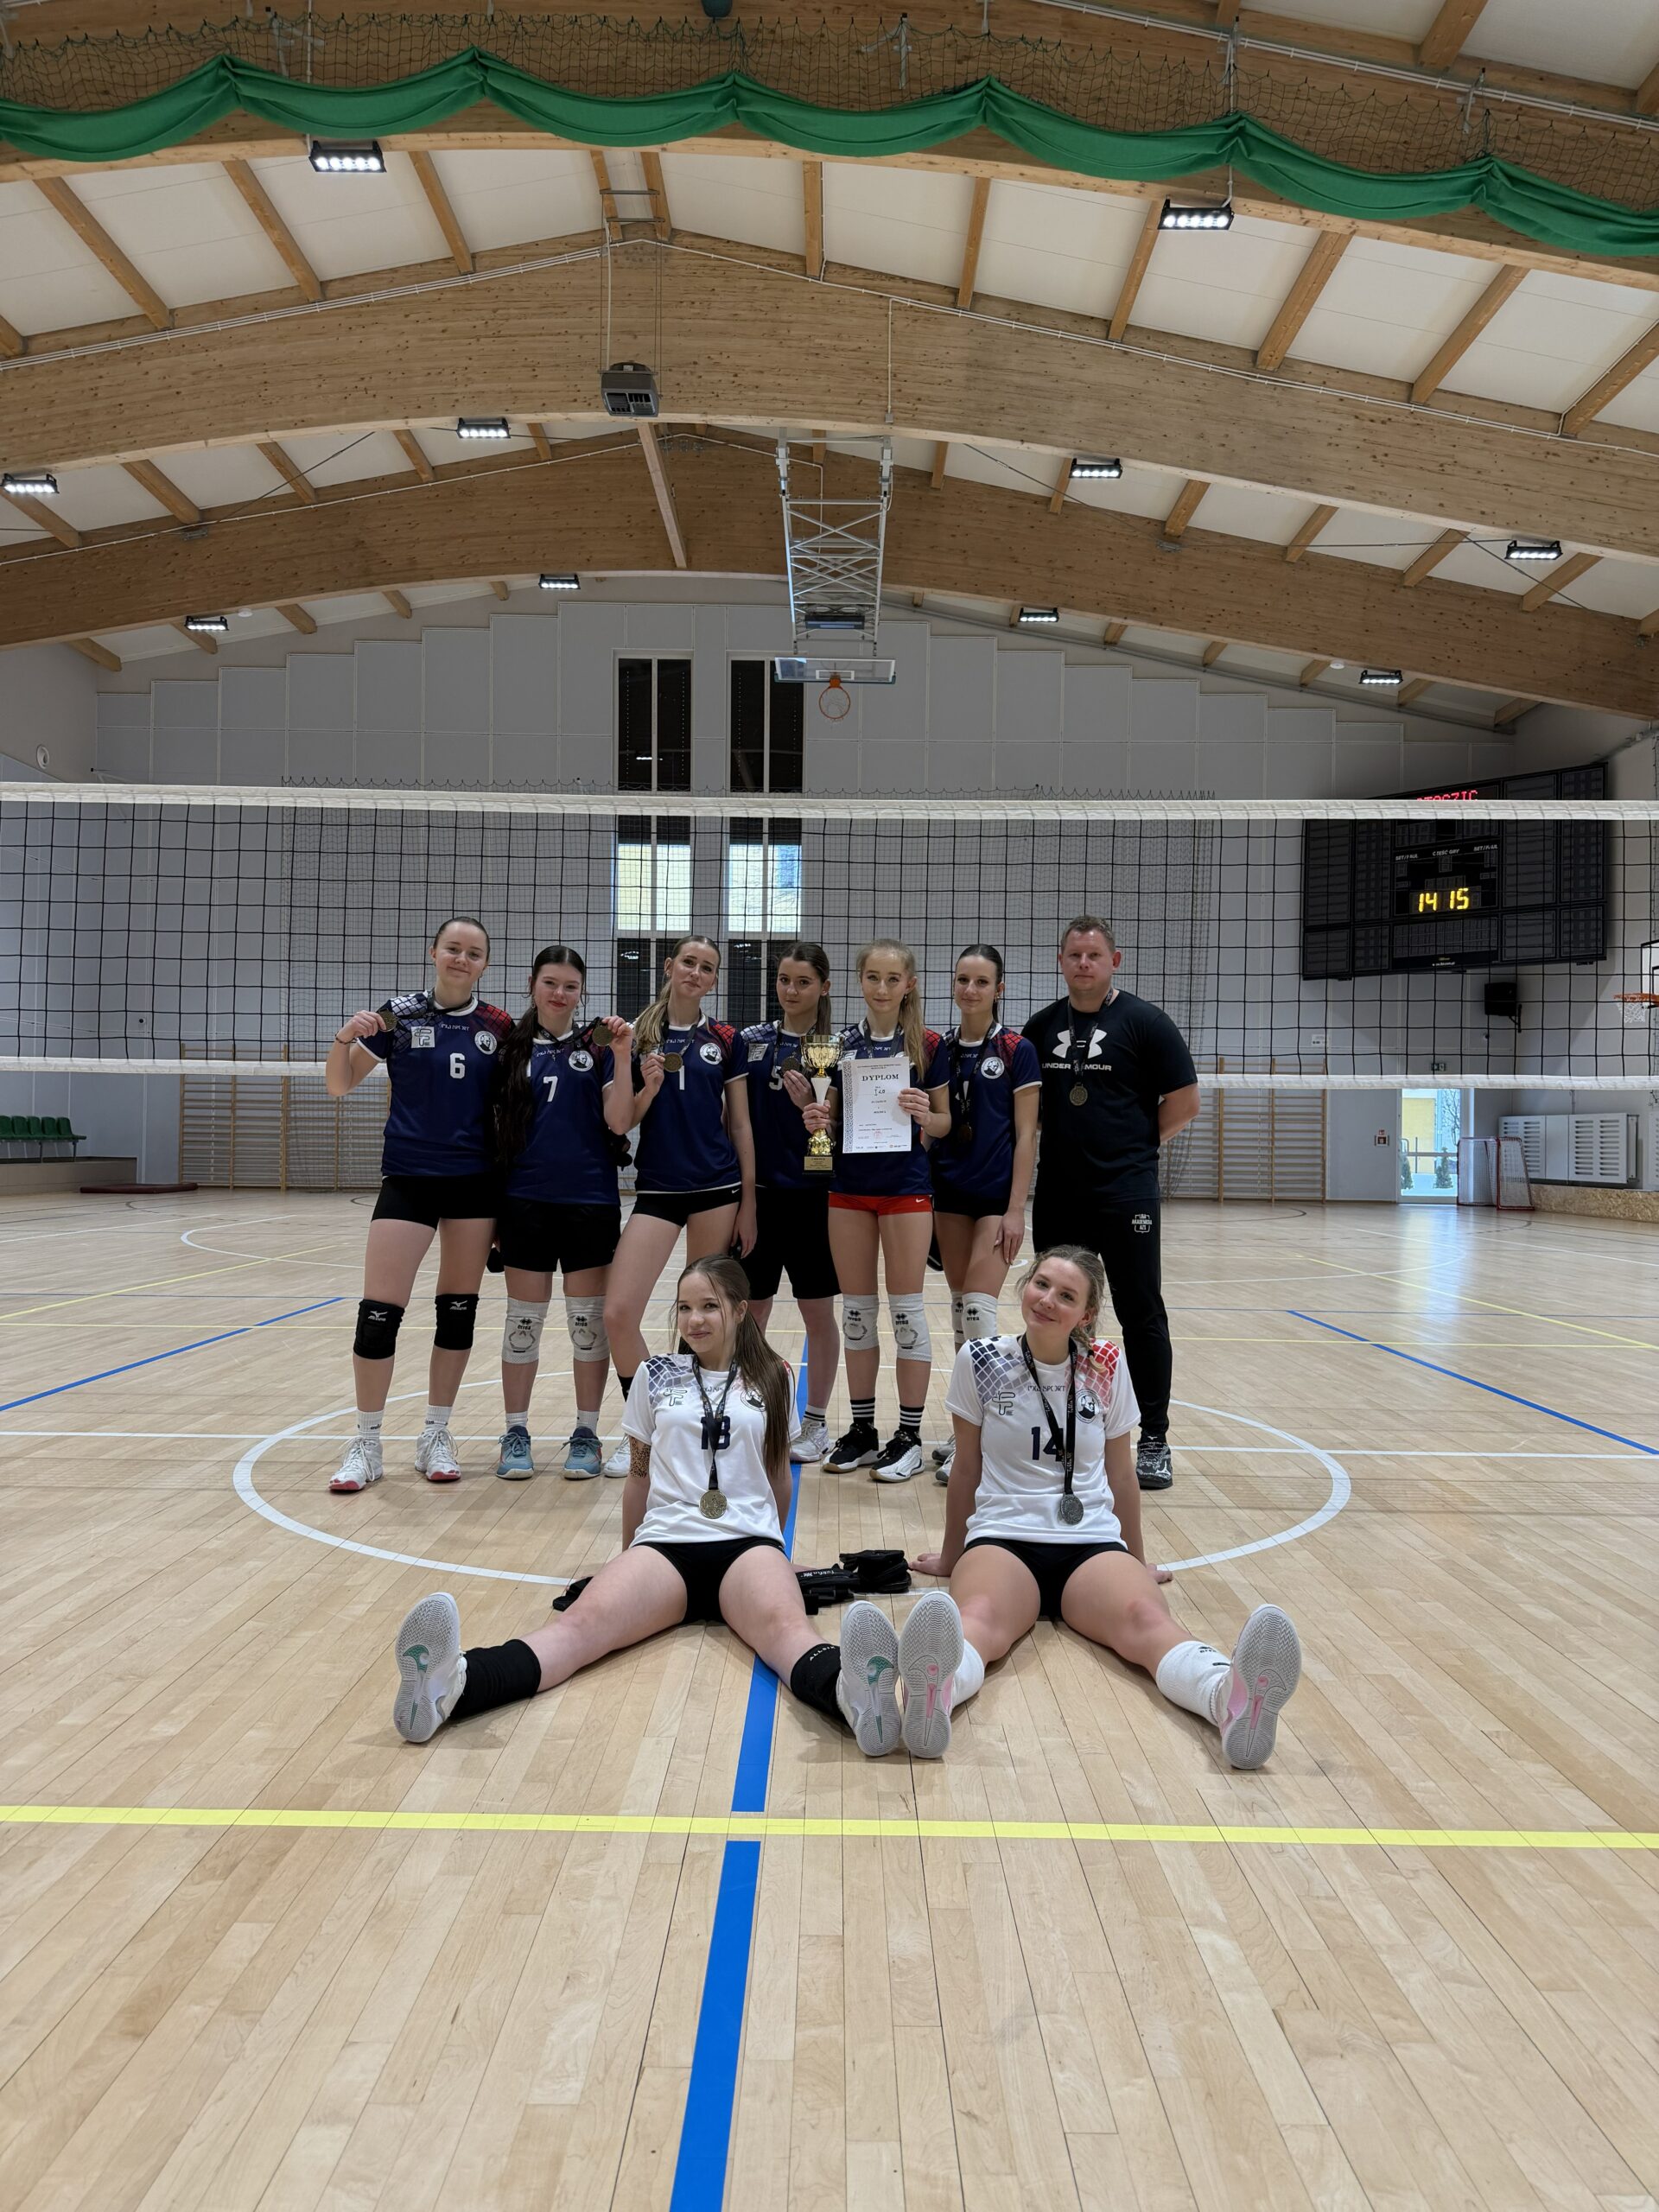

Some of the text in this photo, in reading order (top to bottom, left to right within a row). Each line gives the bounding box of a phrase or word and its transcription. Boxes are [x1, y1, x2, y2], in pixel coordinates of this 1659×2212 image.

[1418, 887, 1470, 912] 14 15
[449, 1052, 466, 1079] 6
[678, 1065, 685, 1090] 1
[1079, 1063, 1112, 1071] MOUR
[543, 1076, 558, 1102] 7
[1031, 1427, 1064, 1462] 14
